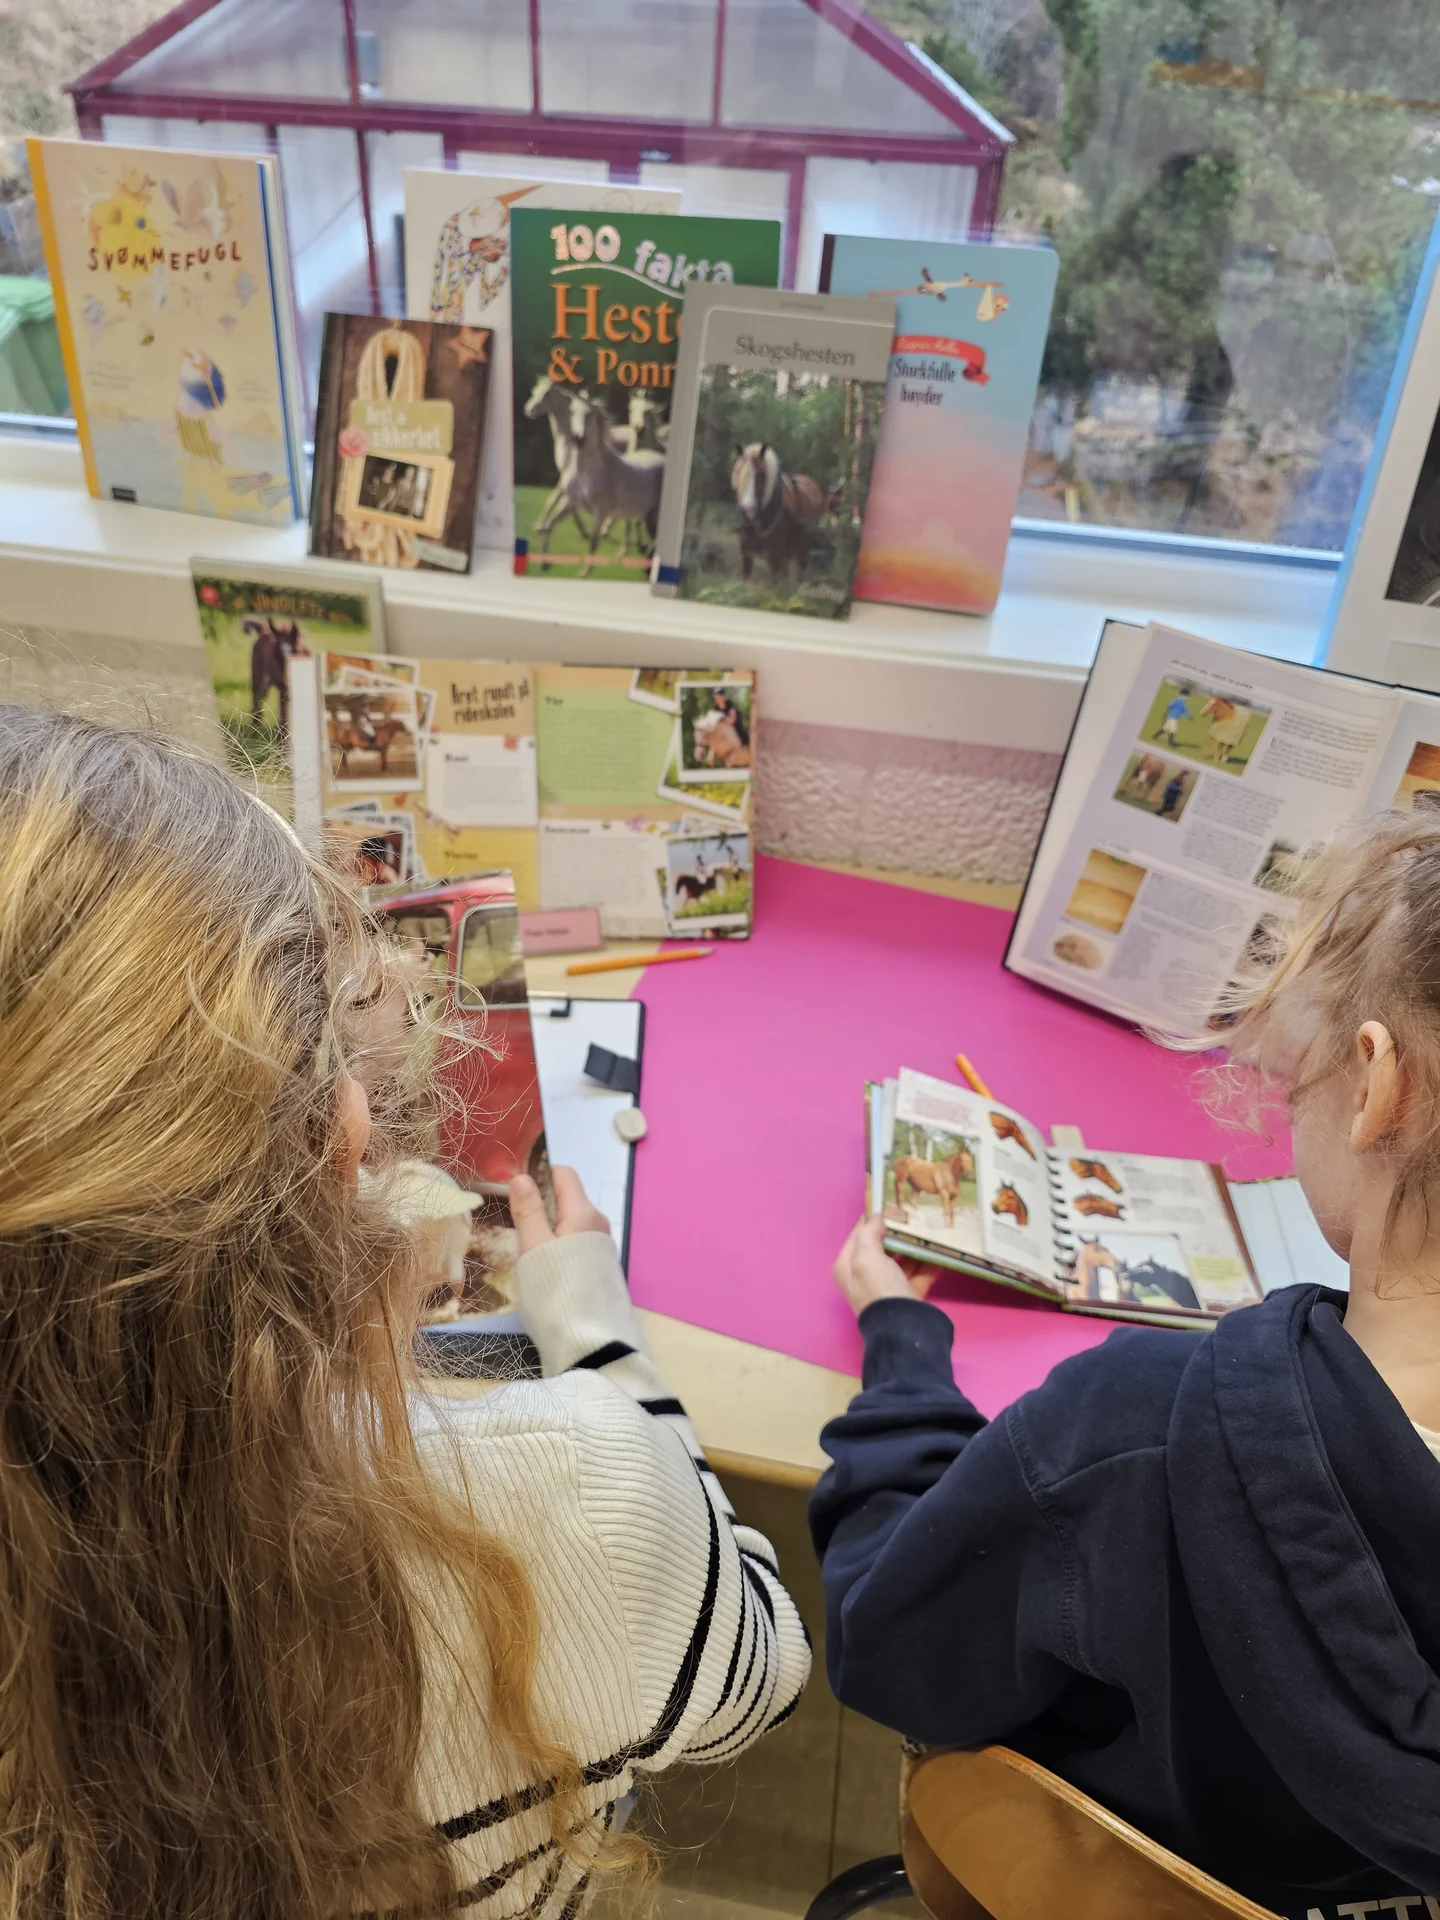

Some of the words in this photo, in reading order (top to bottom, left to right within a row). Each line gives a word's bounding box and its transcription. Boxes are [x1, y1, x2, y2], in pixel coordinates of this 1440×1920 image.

[87, 240, 242, 273] SVØMMEFUGL
[550, 224, 622, 262] 100
[634, 240, 735, 288] fakta
[548, 346, 584, 384] &
[735, 333, 857, 367] Skogshesten
